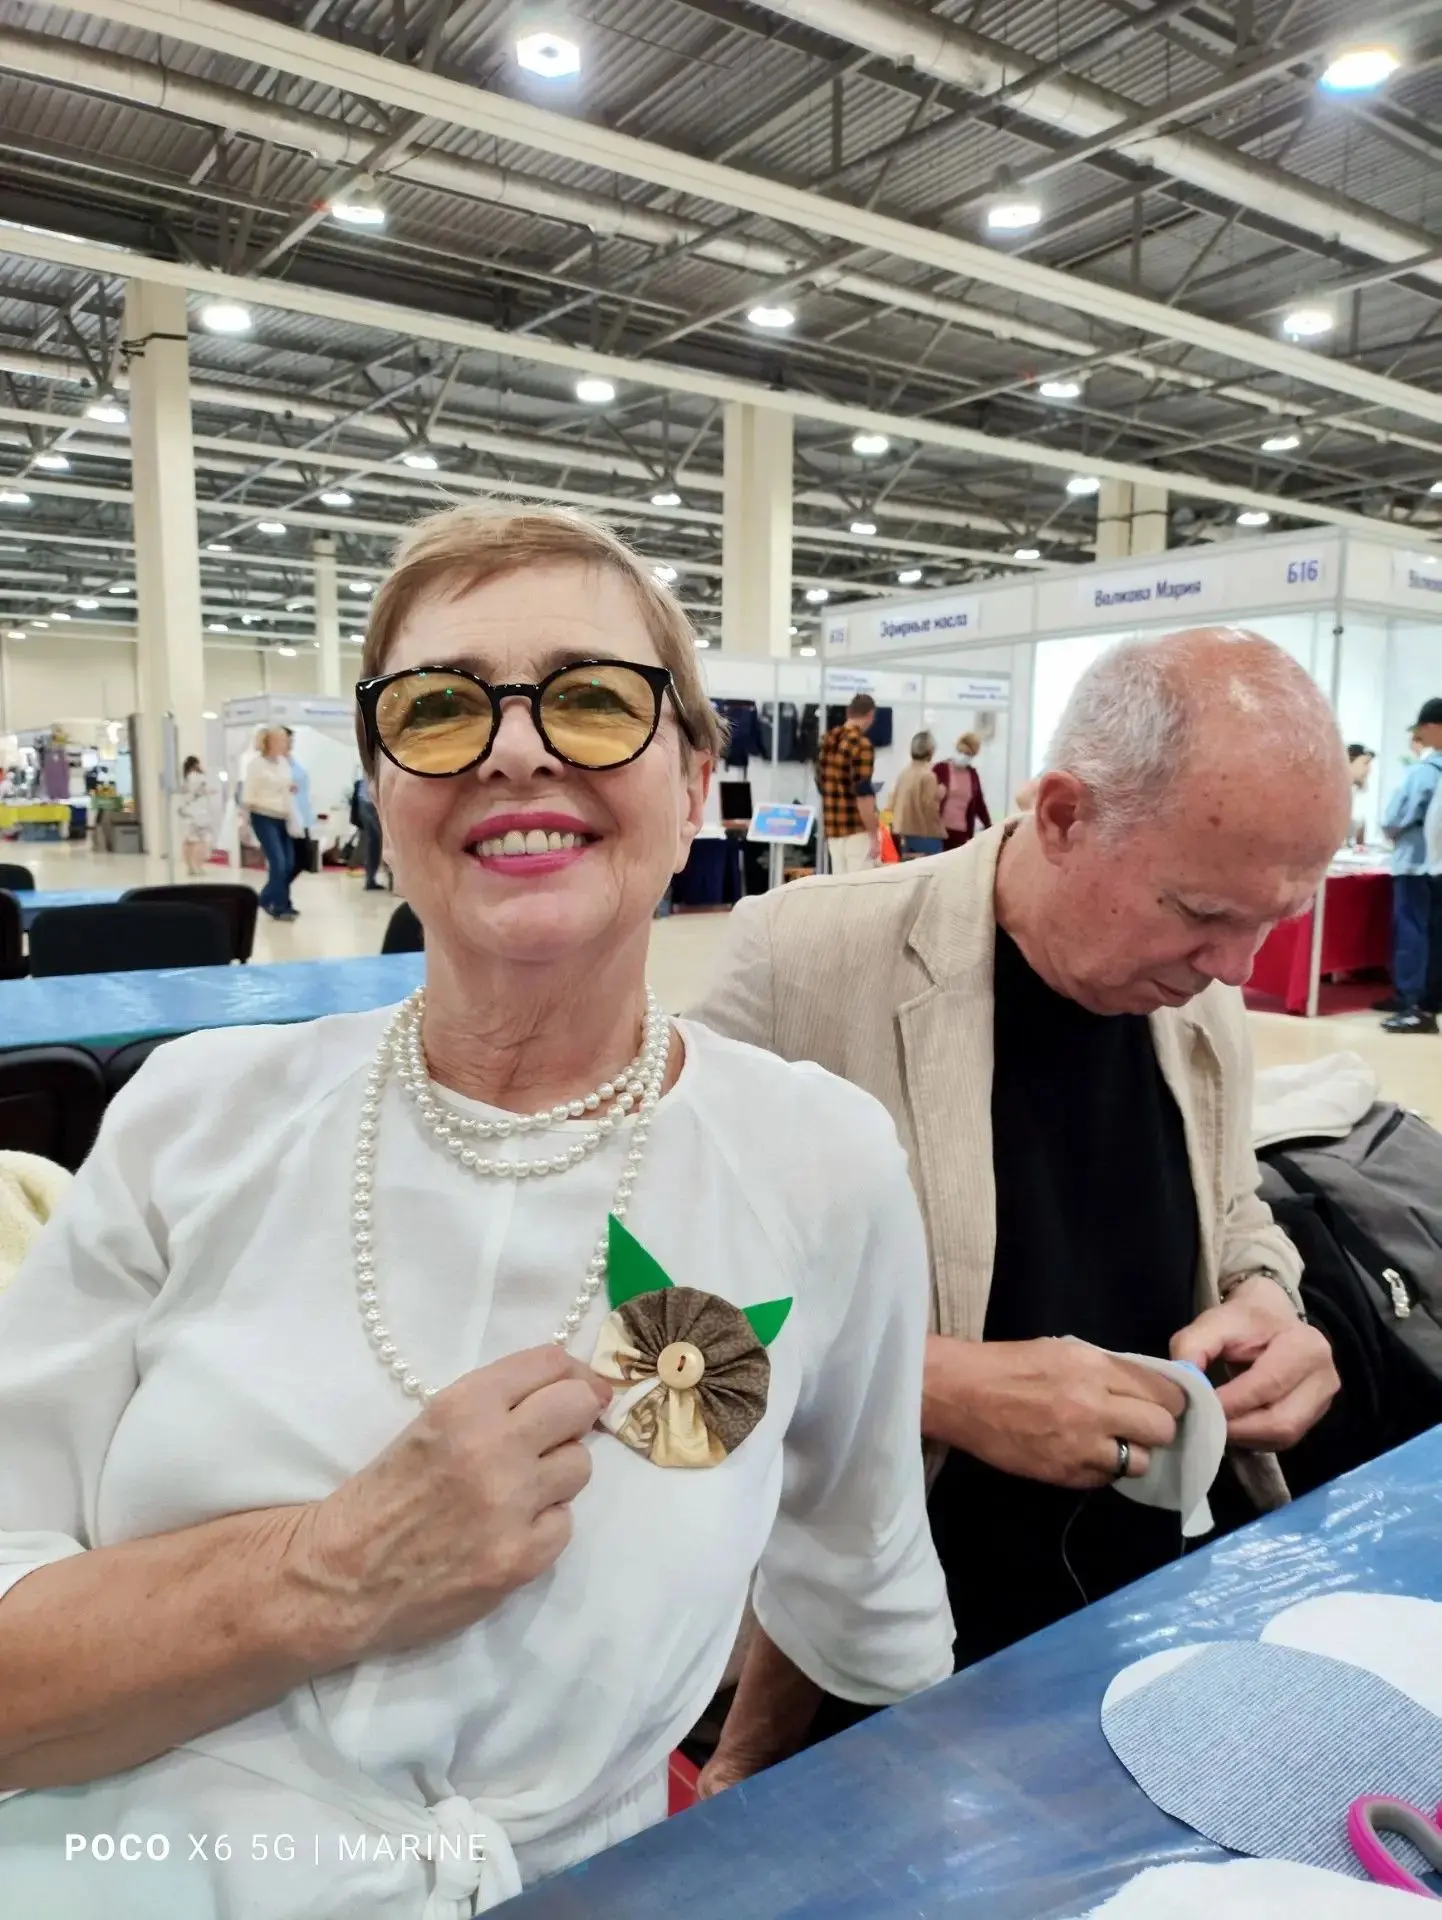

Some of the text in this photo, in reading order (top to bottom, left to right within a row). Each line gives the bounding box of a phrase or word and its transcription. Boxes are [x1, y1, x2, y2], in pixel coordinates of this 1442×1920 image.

[1155, 579, 1202, 602] Мария
[880, 613, 968, 639] Эфирные масла
